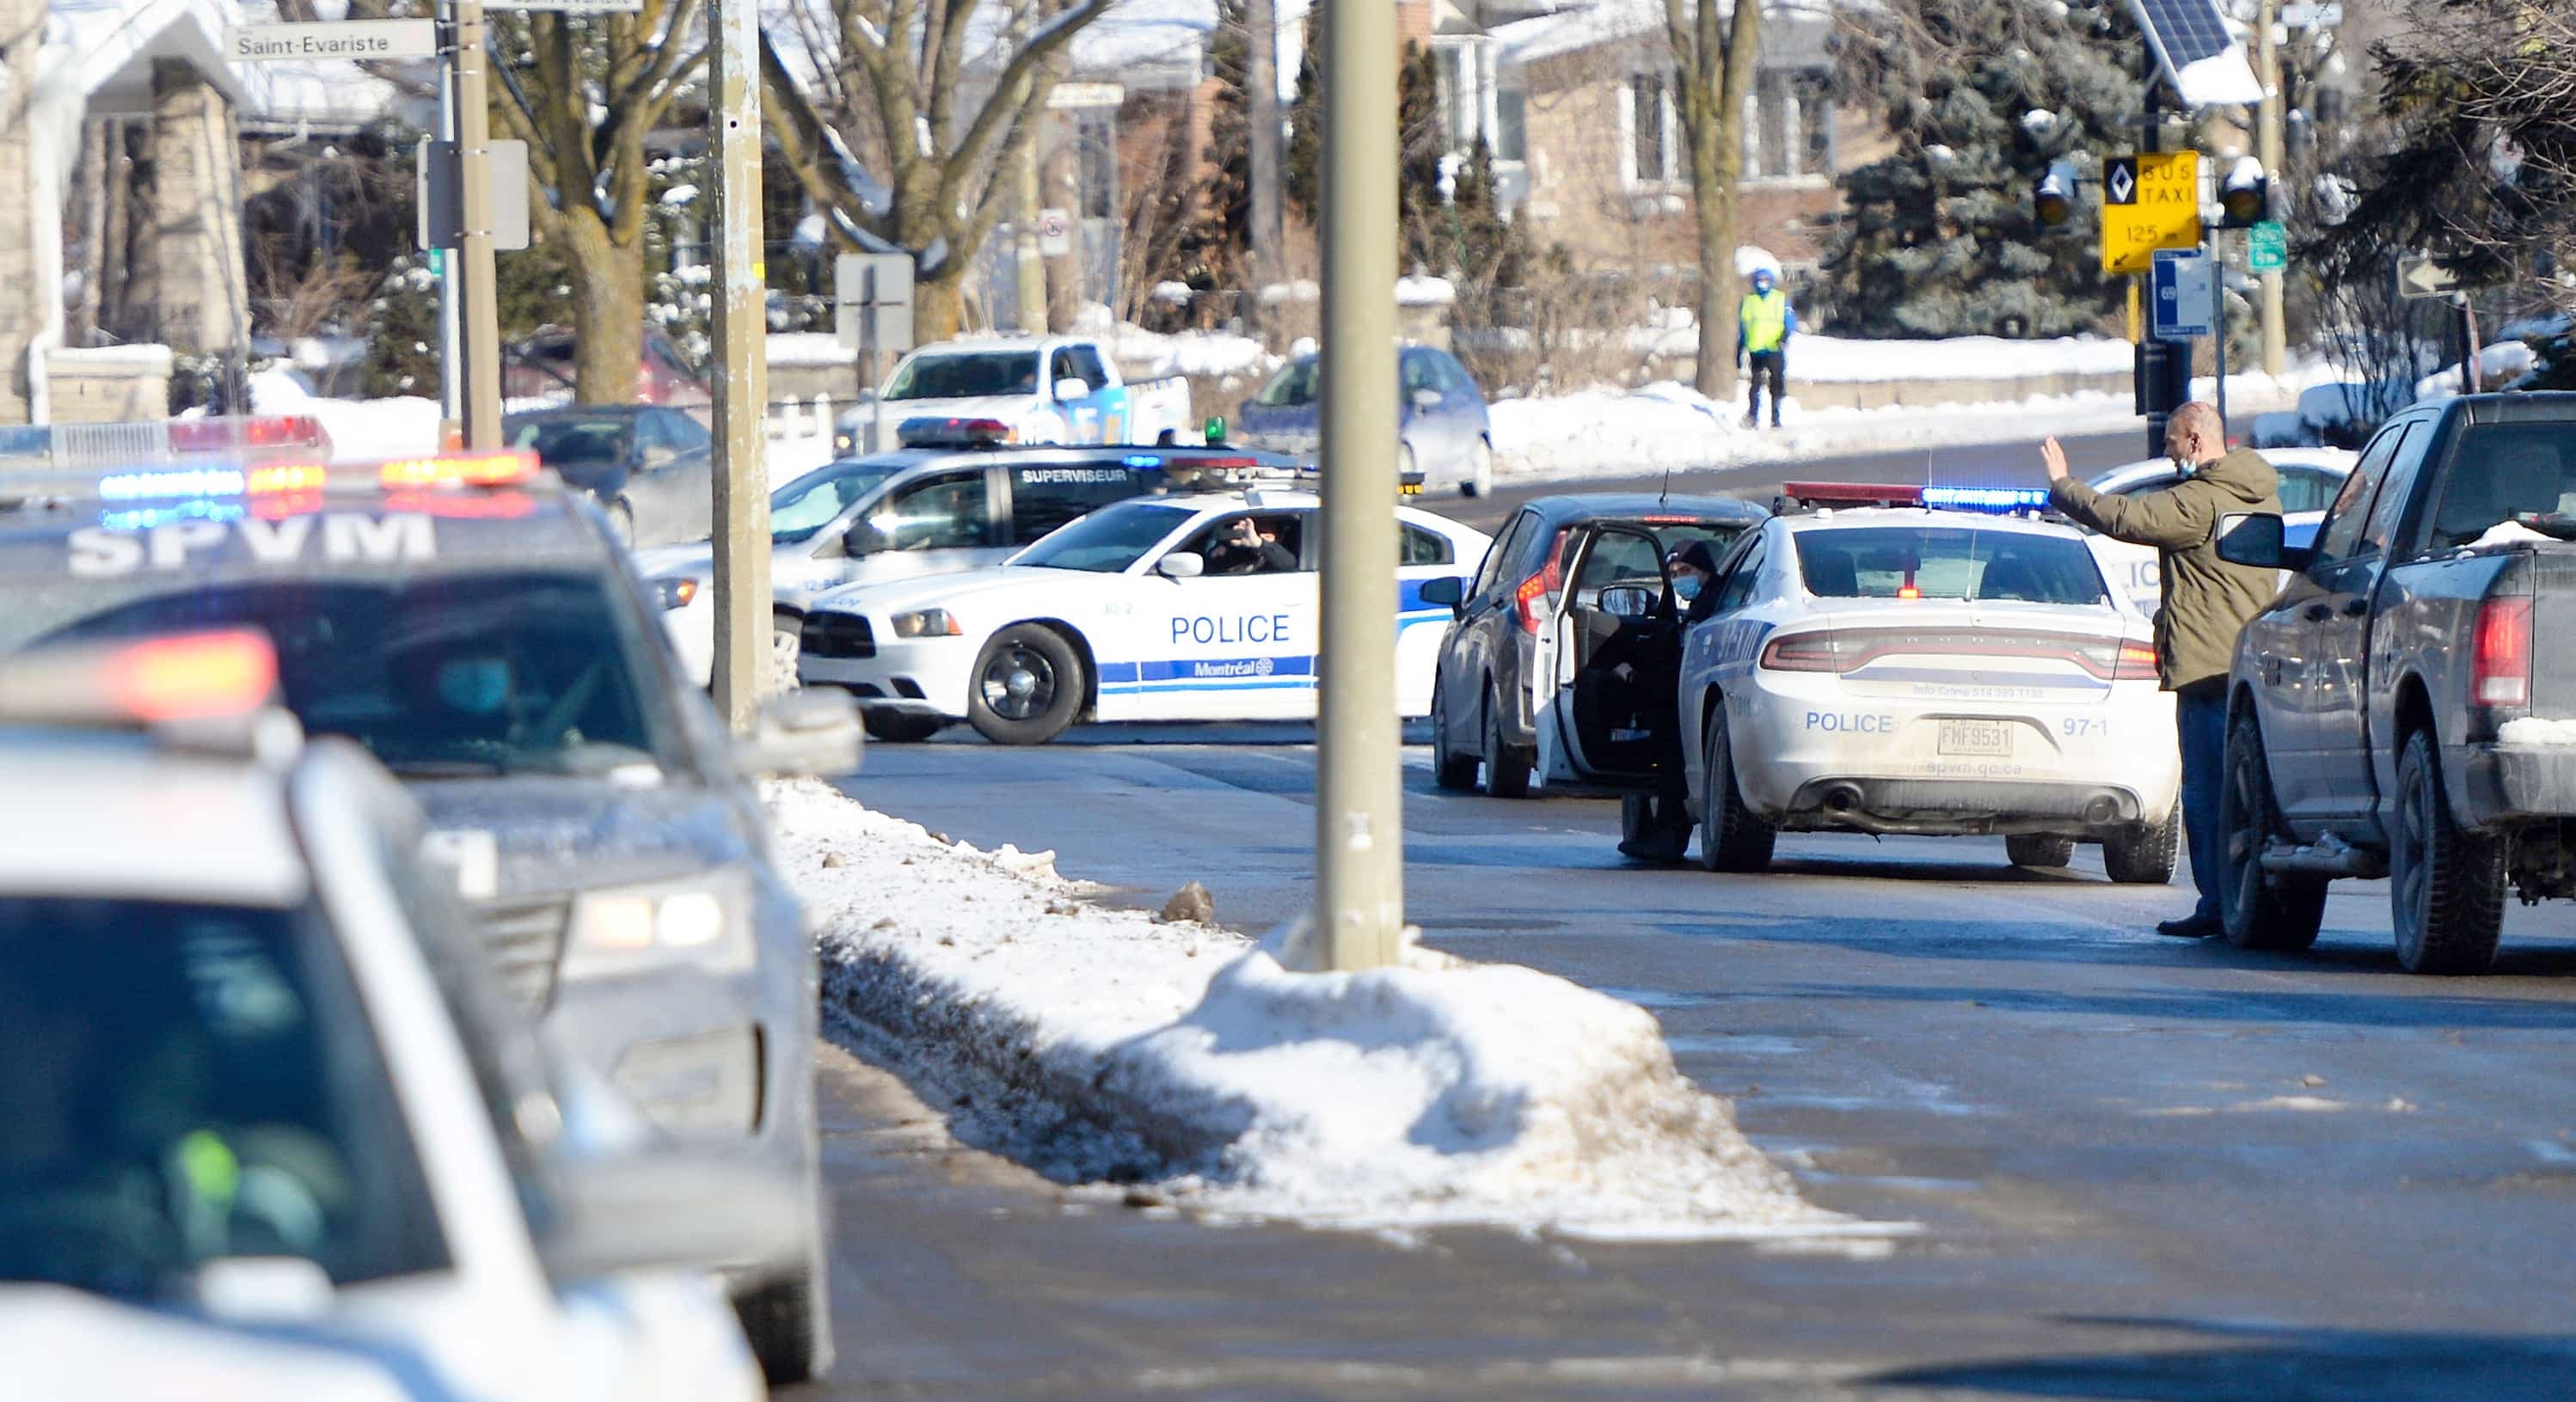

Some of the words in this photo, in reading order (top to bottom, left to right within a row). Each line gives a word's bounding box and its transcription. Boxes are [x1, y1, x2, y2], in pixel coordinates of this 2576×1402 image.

[238, 36, 389, 55] Saint-Evariste
[2142, 164, 2192, 181] BUS
[2144, 187, 2193, 203] TAXI
[2127, 225, 2158, 242] 125
[2161, 286, 2177, 300] 69
[1021, 469, 1127, 482] SUPERVISEUR
[68, 514, 437, 578] SPVM
[1171, 614, 1291, 645] POLICE
[1194, 660, 1256, 677] Montréal
[1913, 684, 1934, 695] Info
[1939, 685, 1970, 697] Crime
[1972, 687, 1993, 698] 514
[1806, 712, 1893, 734] POLICE
[2063, 717, 2108, 737] 97-1
[1941, 726, 2009, 746] FMF9531
[1925, 762, 2022, 778] spvm.qc.ca
